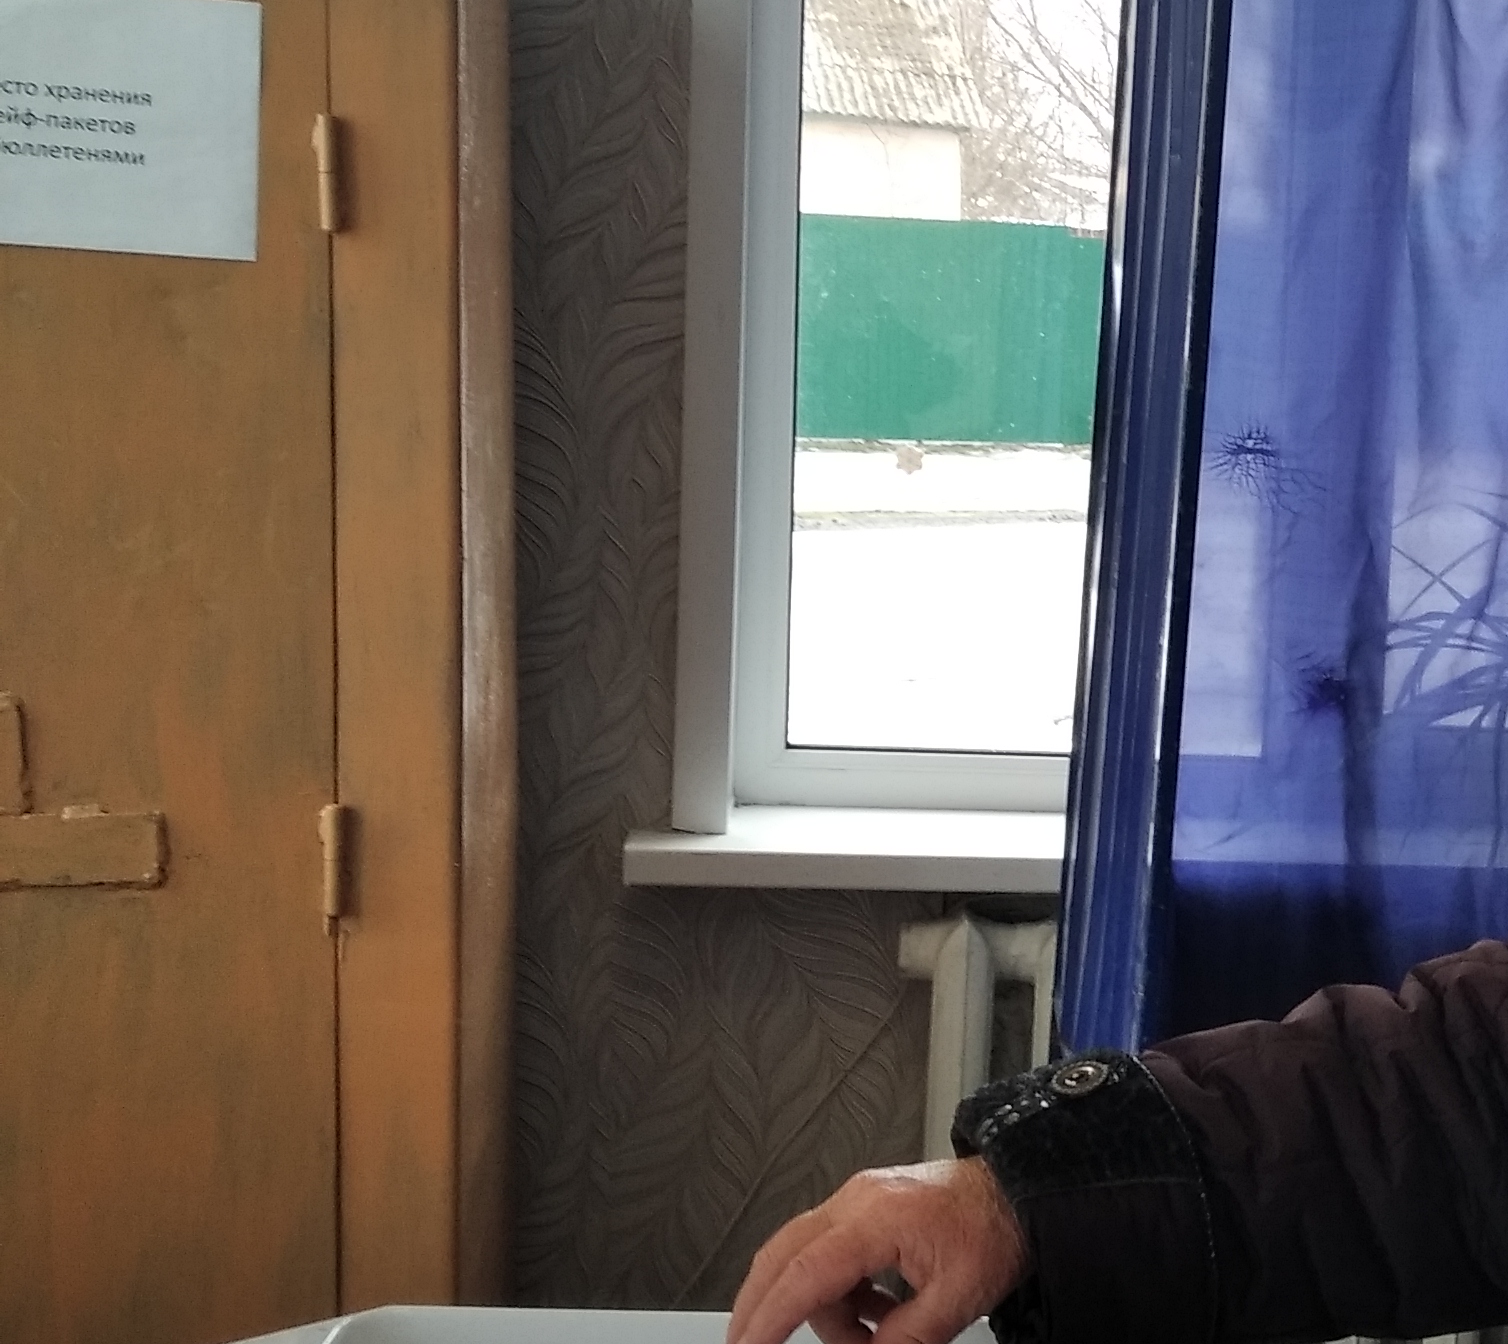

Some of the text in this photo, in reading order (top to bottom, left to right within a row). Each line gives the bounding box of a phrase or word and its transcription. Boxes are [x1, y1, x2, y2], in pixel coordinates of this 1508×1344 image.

[0, 79, 152, 107] сто хранения
[0, 140, 145, 166] юллетенями
